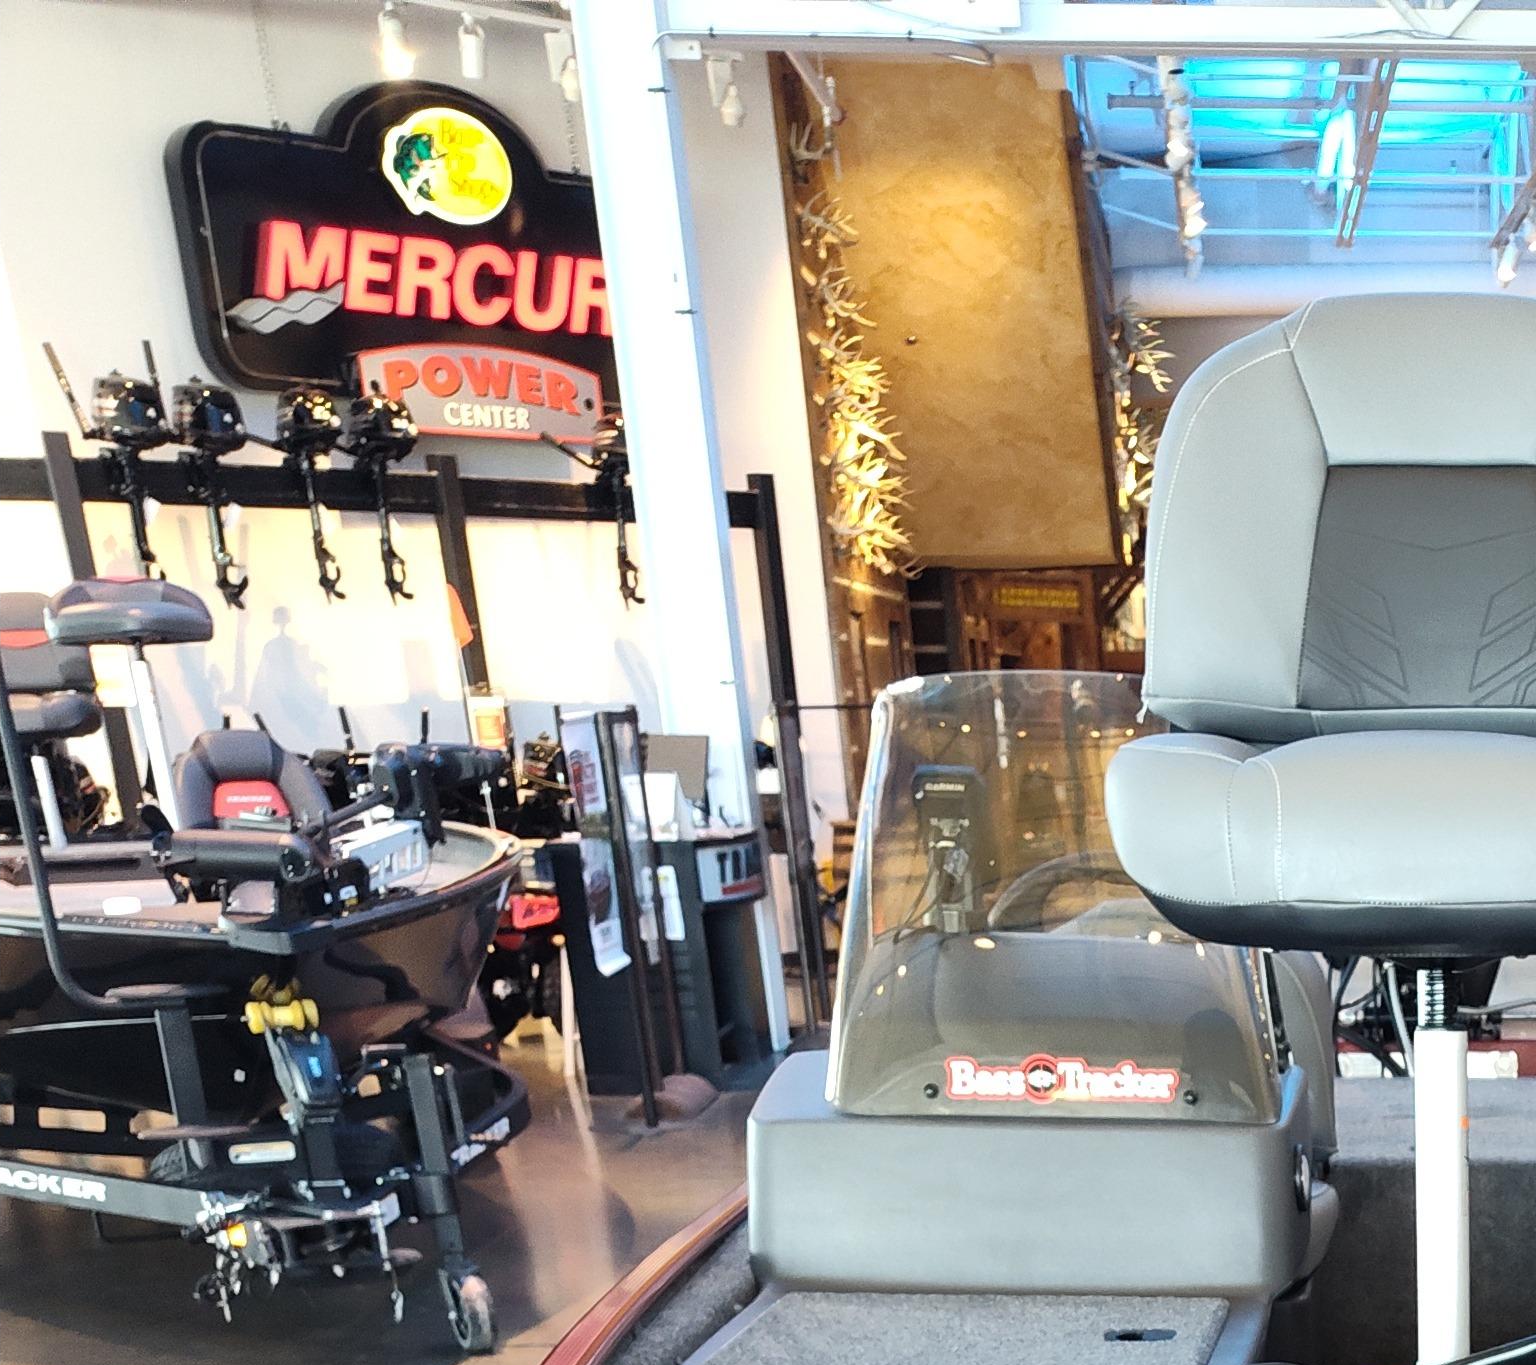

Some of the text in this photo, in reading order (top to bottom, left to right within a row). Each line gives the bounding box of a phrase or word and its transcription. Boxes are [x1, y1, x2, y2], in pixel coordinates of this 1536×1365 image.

[383, 355, 581, 416] POWER
[443, 402, 531, 430] CENTER
[950, 1060, 1175, 1100] Bass Tracker
